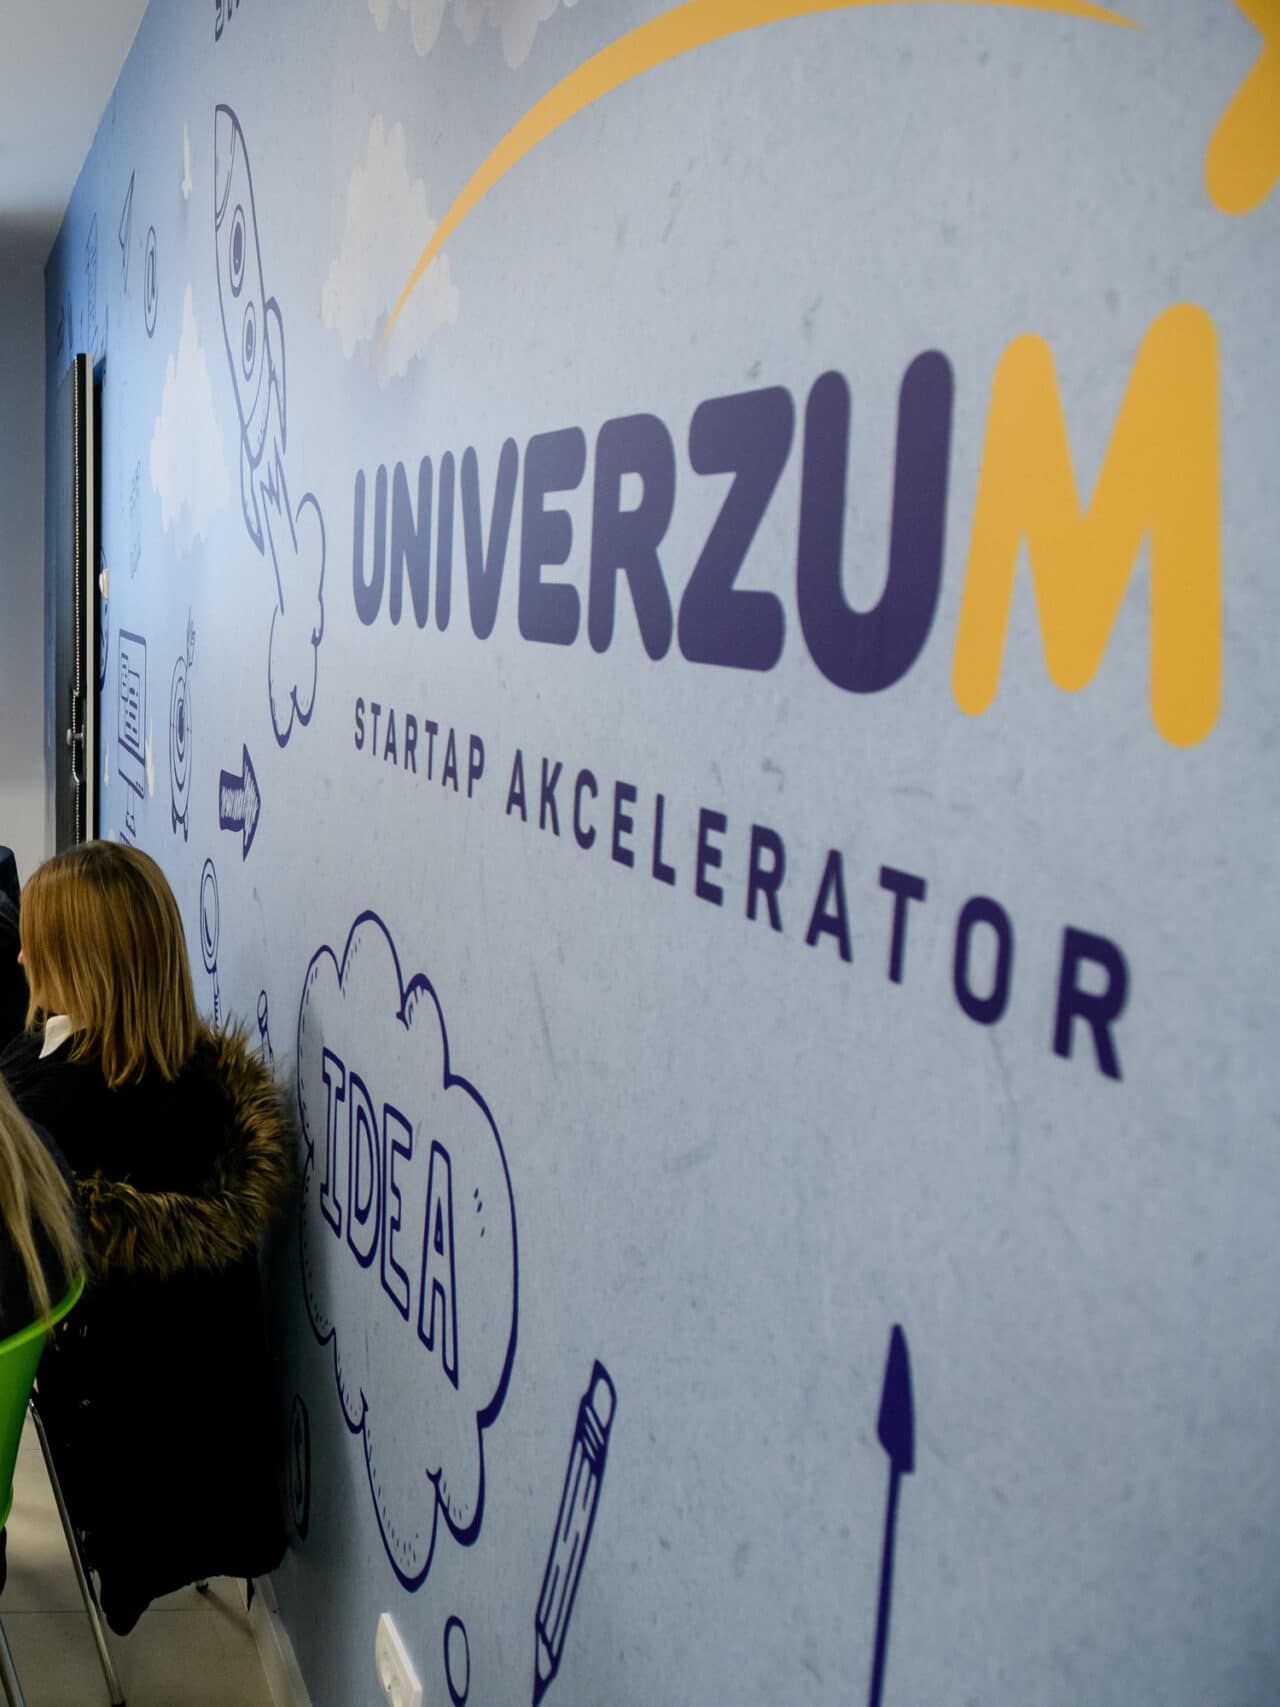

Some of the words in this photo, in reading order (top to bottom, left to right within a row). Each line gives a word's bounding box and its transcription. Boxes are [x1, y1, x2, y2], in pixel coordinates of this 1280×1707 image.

[351, 302, 1223, 748] UNIVERZUM
[354, 697, 486, 799] STARTAP
[505, 748, 1132, 1081] AKCELERATOR
[320, 1047, 459, 1391] IDEA
